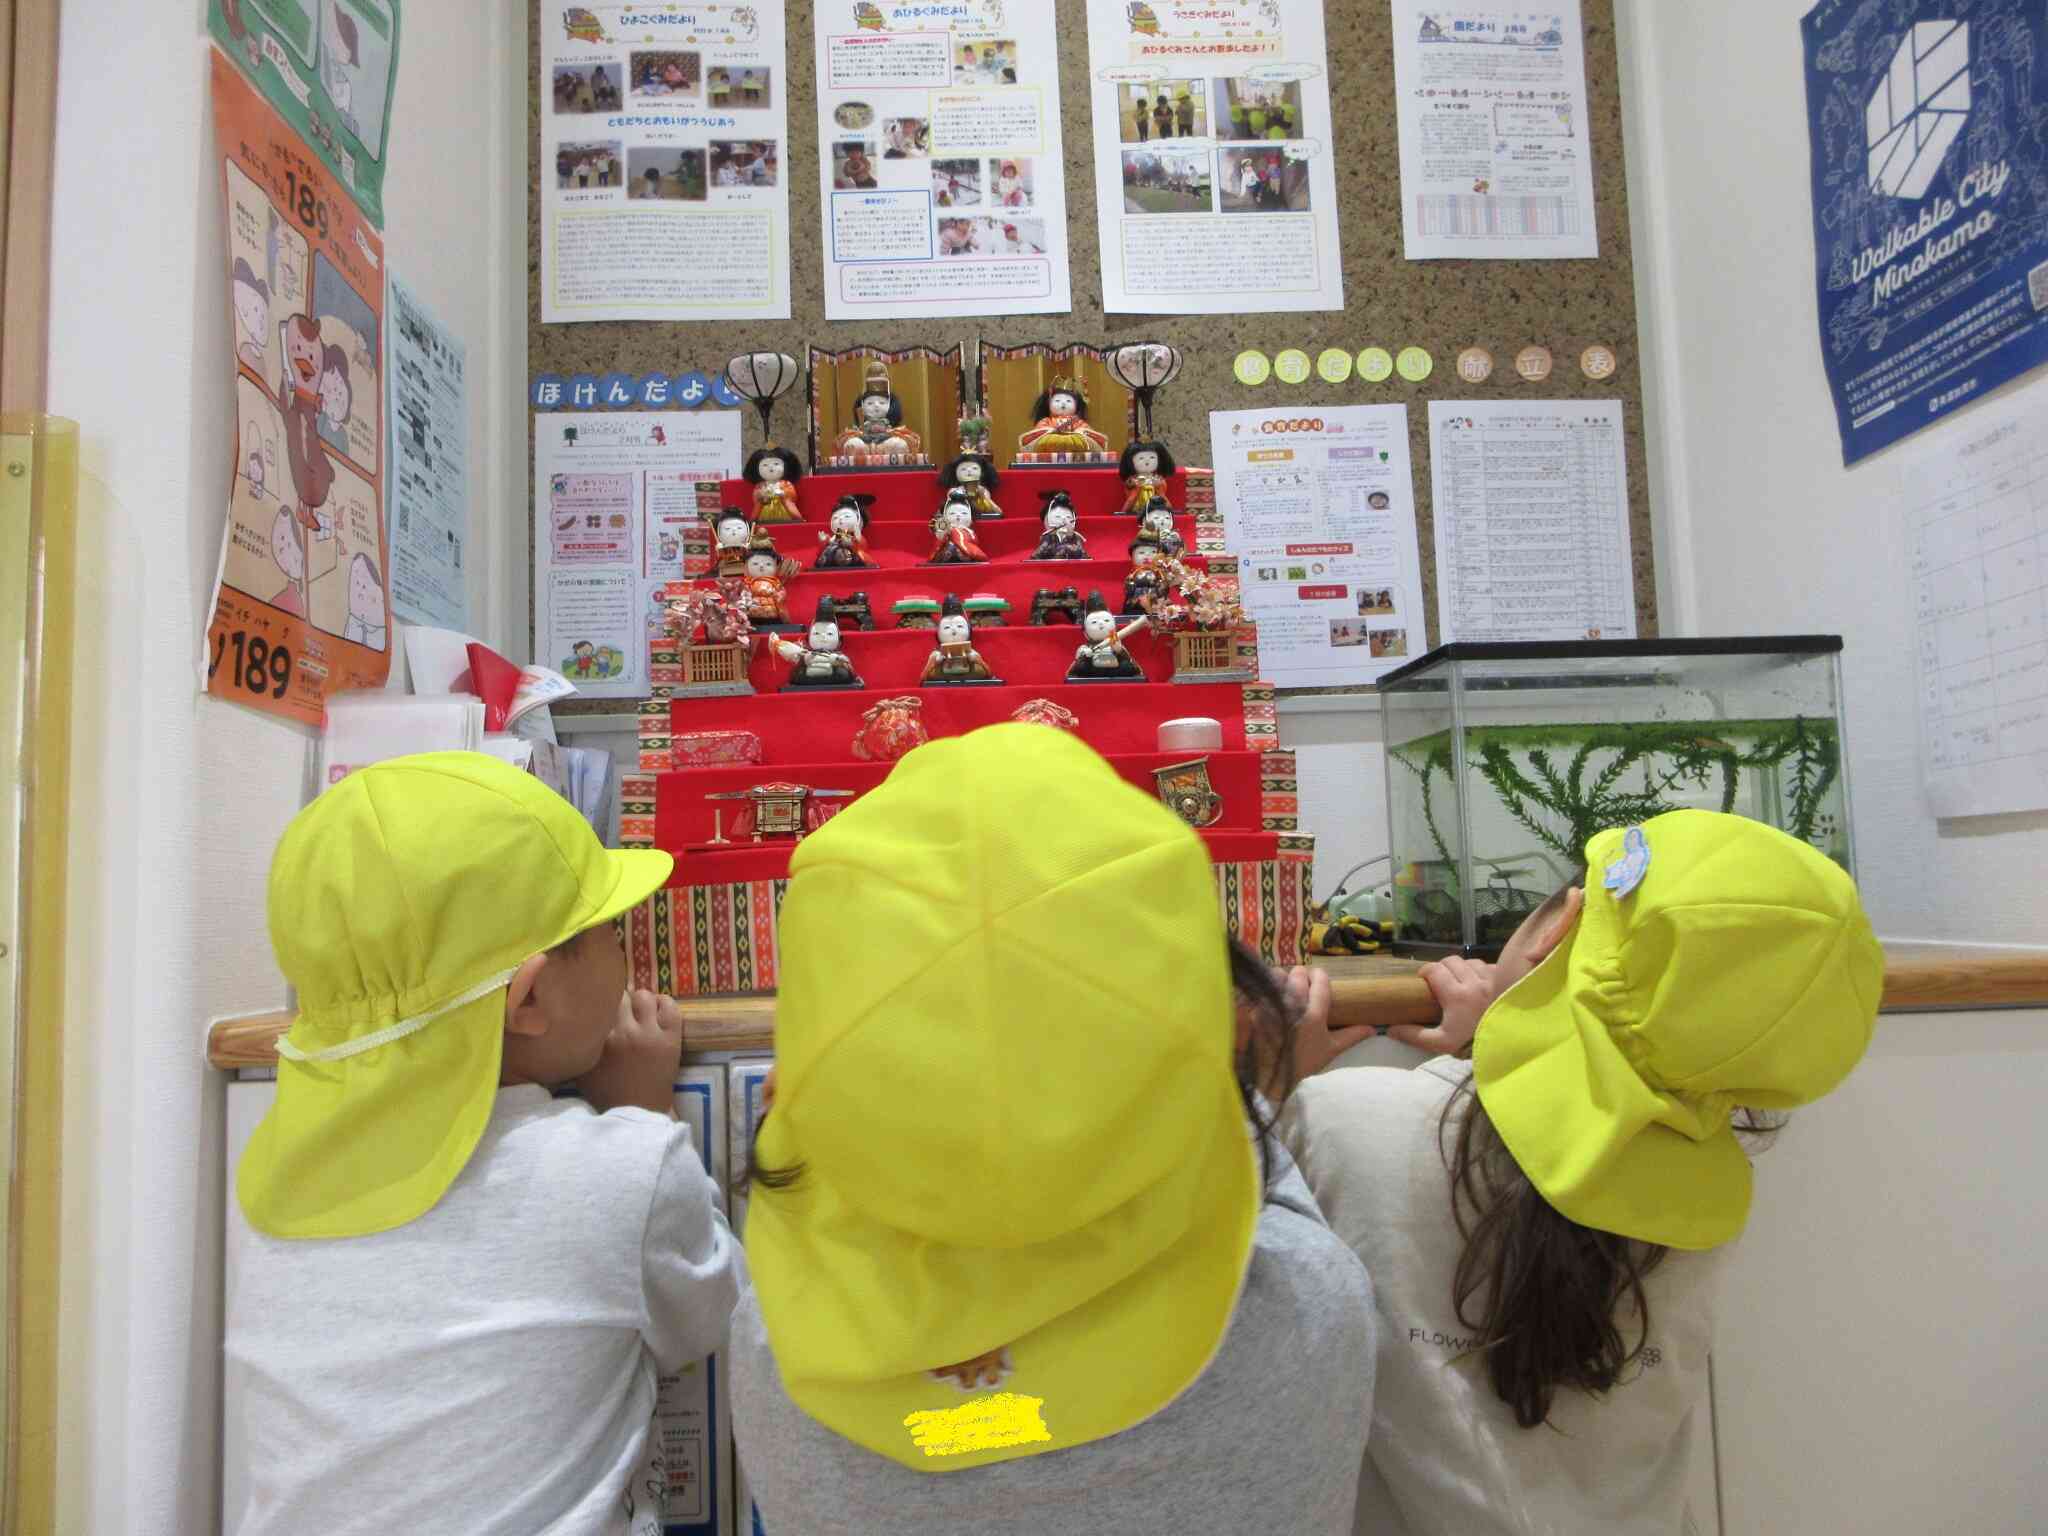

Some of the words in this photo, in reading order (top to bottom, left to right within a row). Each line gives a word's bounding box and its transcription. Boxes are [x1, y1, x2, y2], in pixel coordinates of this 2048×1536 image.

[285, 170, 329, 240] 189
[1852, 197, 1956, 284] Walkable
[1958, 159, 2011, 208] City
[1873, 209, 1998, 309] Minokamo
[230, 630, 291, 700] 189
[1408, 1328, 1473, 1351] FLOW
